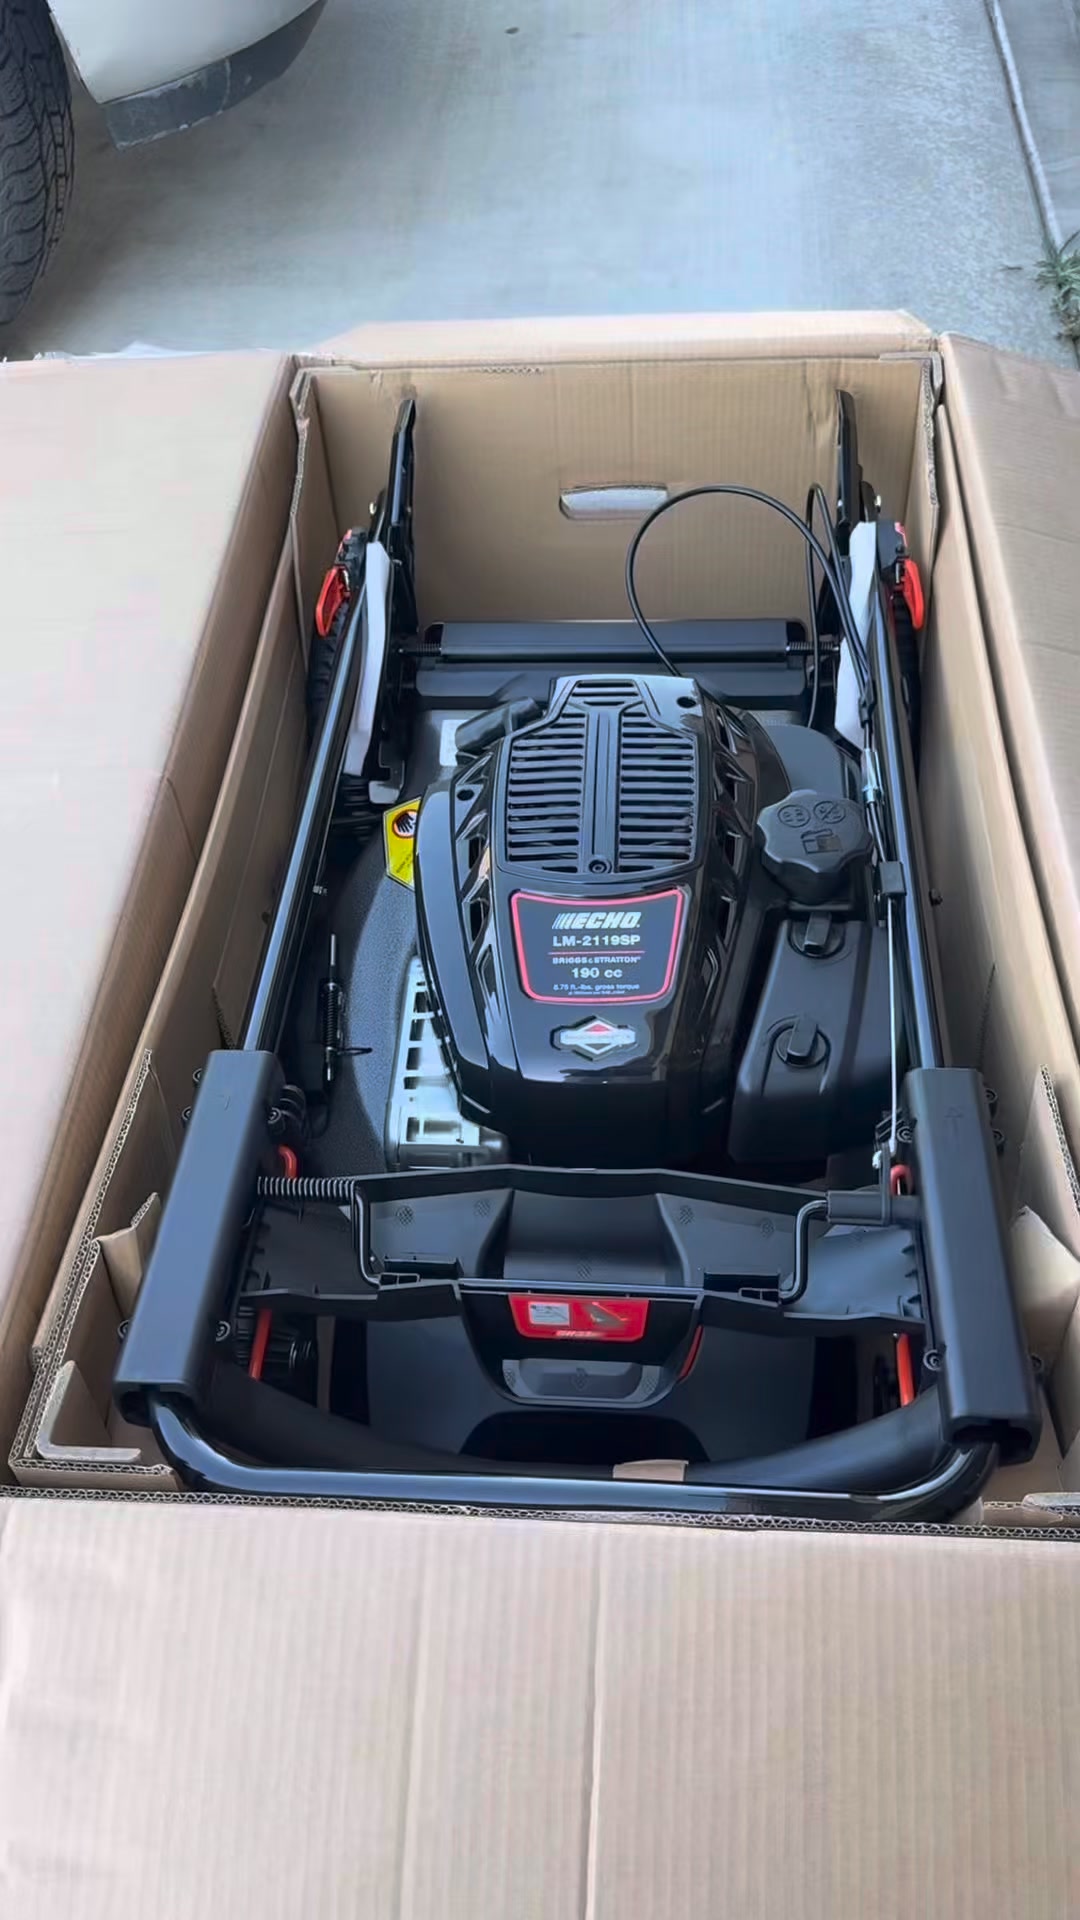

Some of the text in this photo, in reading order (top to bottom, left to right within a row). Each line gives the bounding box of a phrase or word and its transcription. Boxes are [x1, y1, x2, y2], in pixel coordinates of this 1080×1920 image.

[552, 935, 640, 947] LM-2119SP
[571, 967, 623, 979] 190 cc
[595, 984, 615, 992] gross
[616, 983, 640, 991] torque
